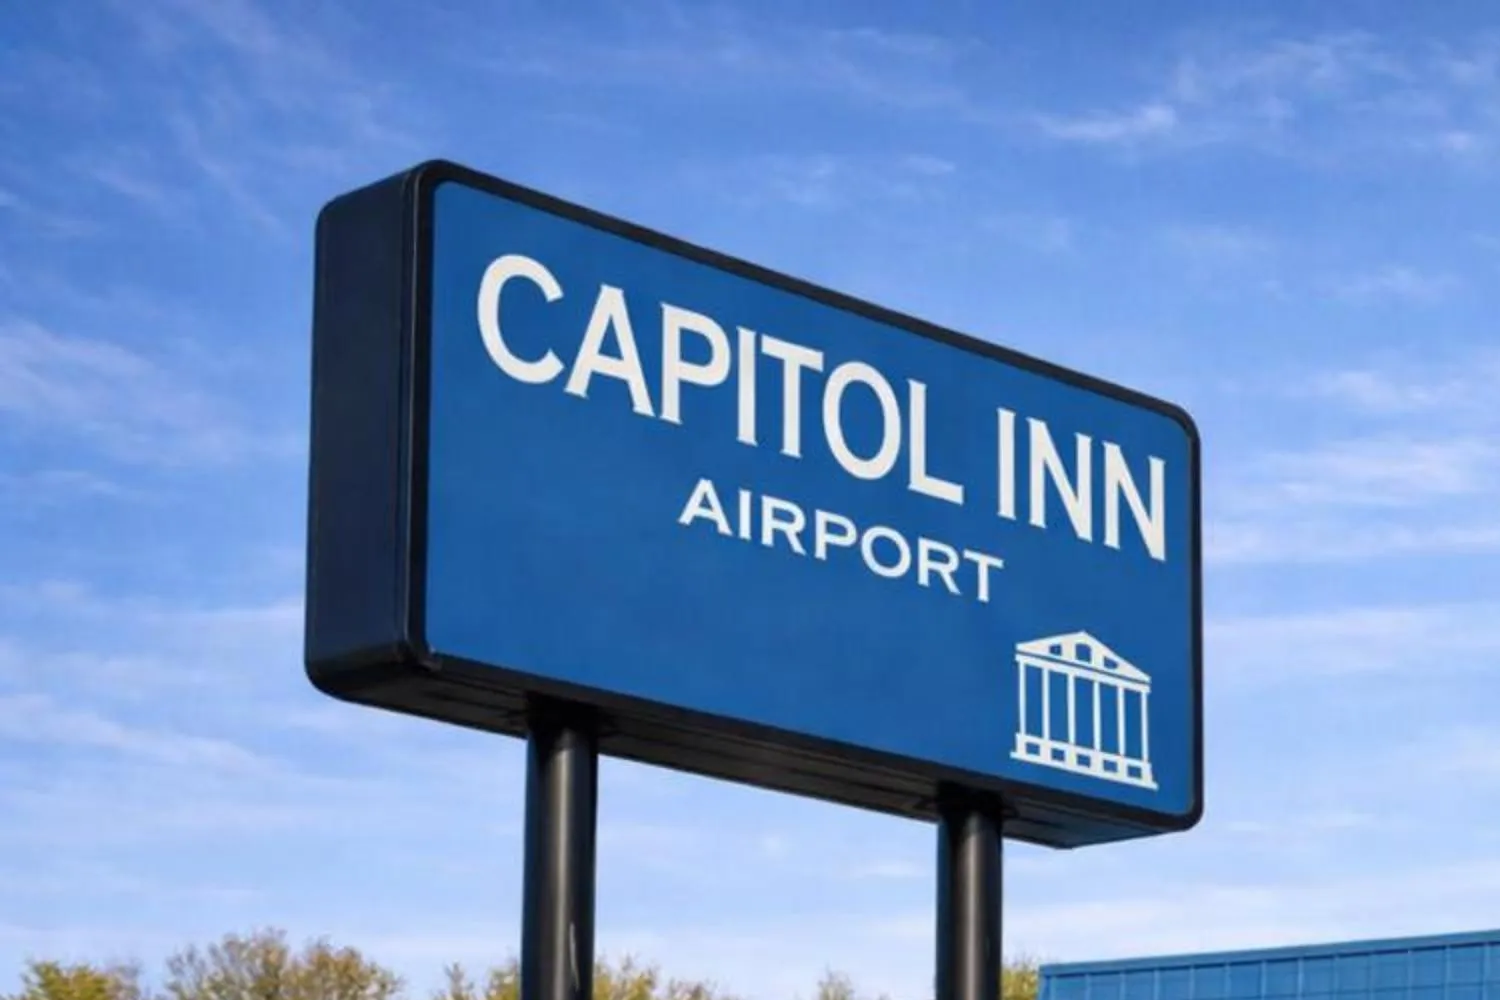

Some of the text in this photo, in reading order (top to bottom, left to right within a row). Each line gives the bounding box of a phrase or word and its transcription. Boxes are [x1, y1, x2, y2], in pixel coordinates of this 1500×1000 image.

[476, 253, 1167, 562] CAPITOL INN
[678, 478, 1004, 603] AIRPORT
